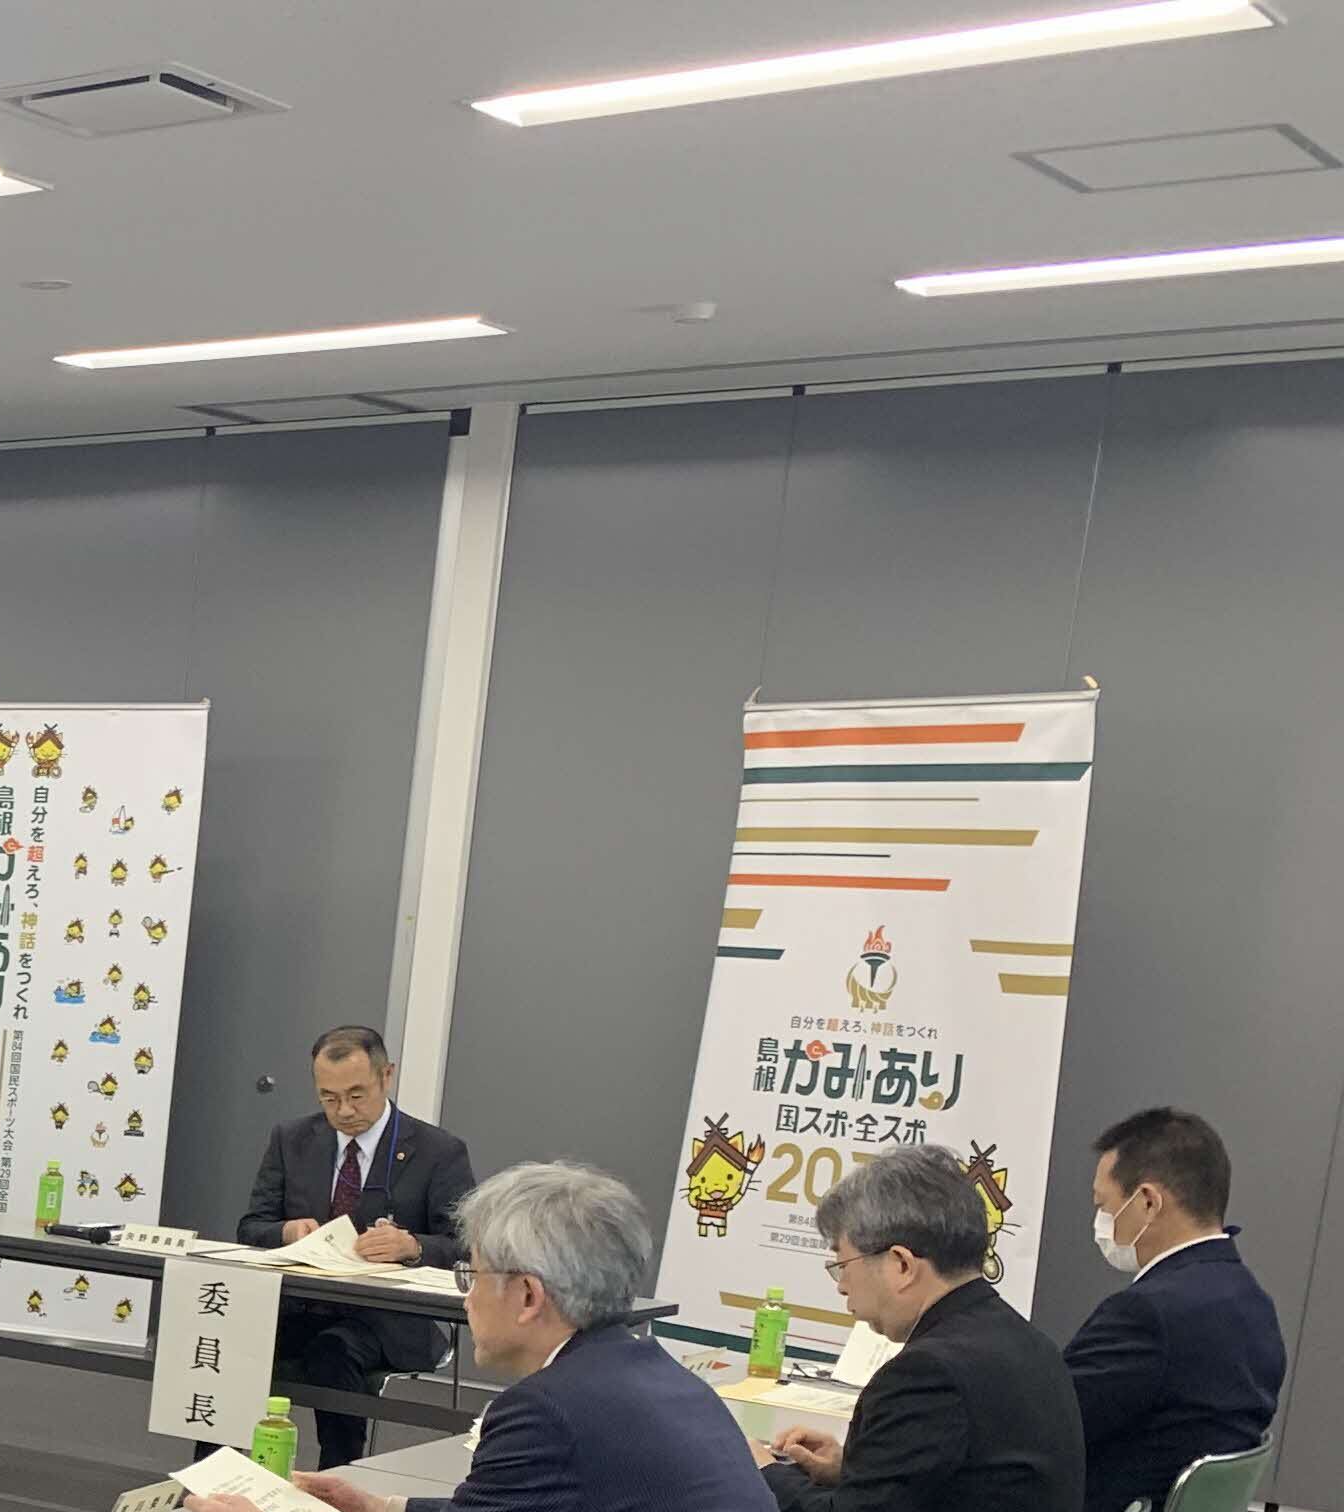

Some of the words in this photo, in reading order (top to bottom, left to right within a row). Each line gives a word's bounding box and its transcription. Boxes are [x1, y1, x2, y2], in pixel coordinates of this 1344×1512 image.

[11, 785, 50, 1020] 自分を超えろ、神話をつくれ
[790, 1016, 938, 1040] 自分を超えろ、神話をつくれ
[776, 1104, 927, 1144] 国スポ・全スポ
[184, 1282, 229, 1427] 委員長
